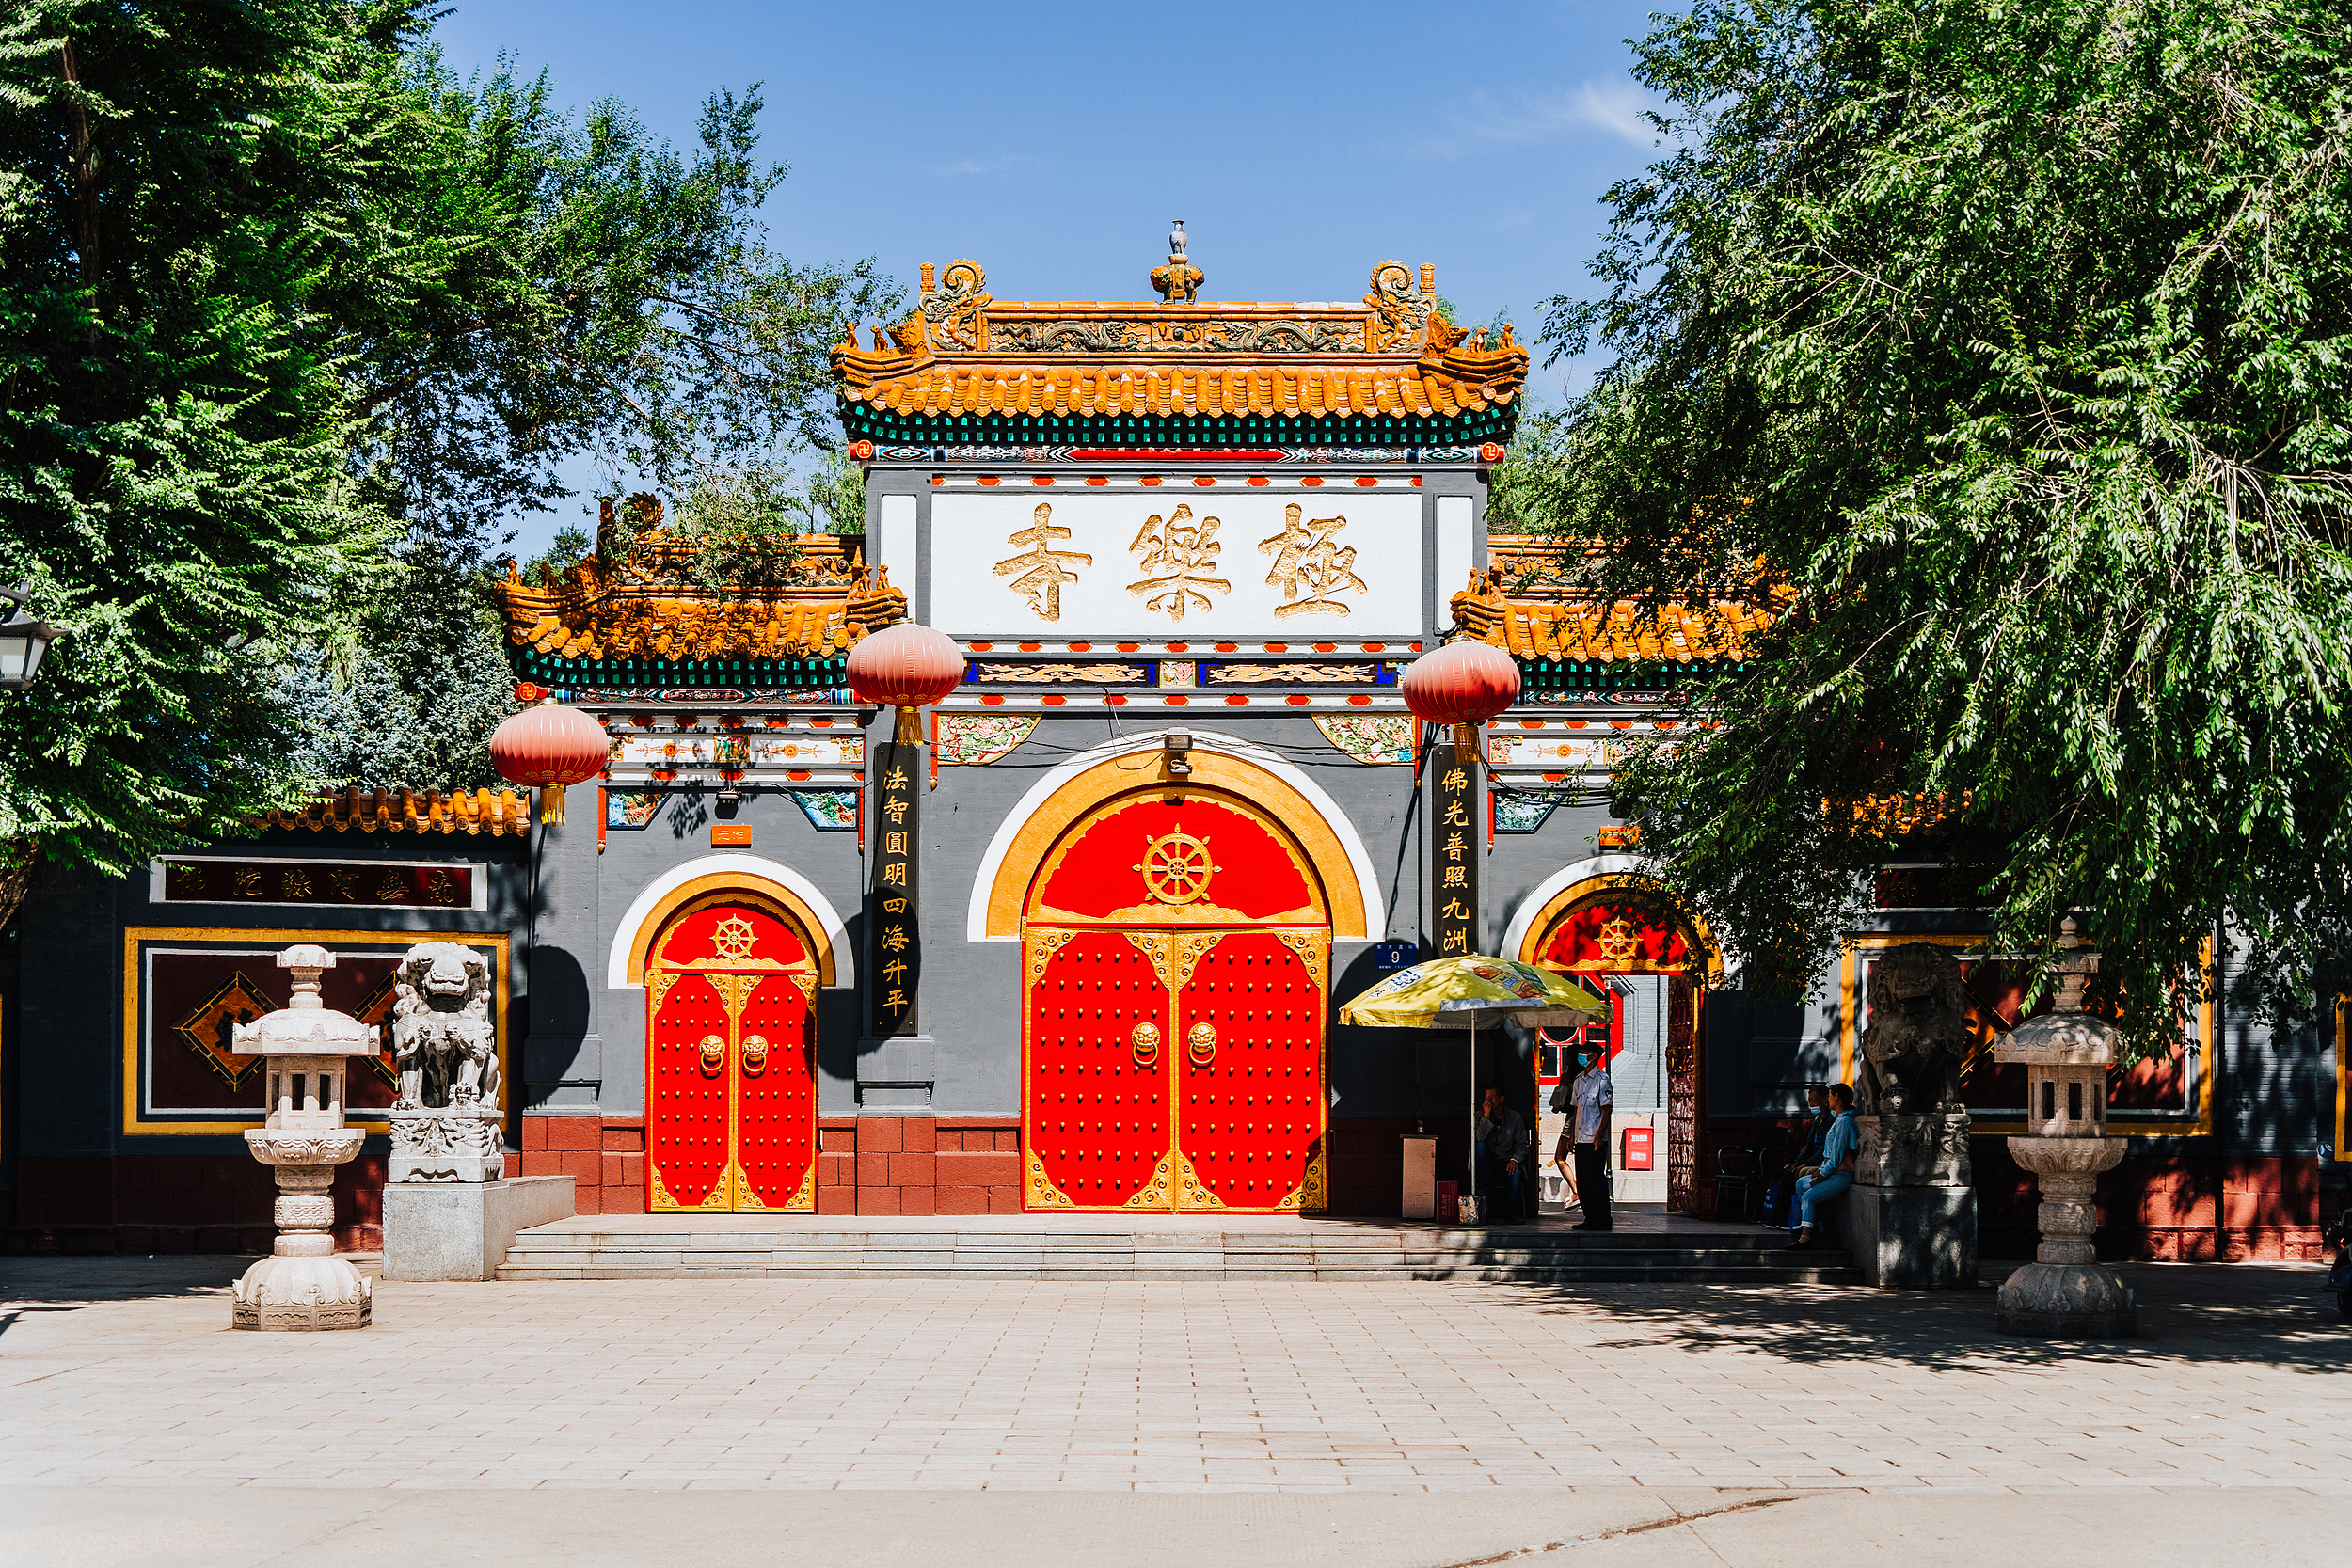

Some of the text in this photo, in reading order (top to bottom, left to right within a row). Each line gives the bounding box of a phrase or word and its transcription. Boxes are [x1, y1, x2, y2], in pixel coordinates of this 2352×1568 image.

[993, 502, 1368, 625] 極樂寺
[882, 765, 909, 1017] 法智圓明四海升平
[1441, 767, 1470, 954] 佛光普照九洲
[1391, 951, 1400, 964] 9
